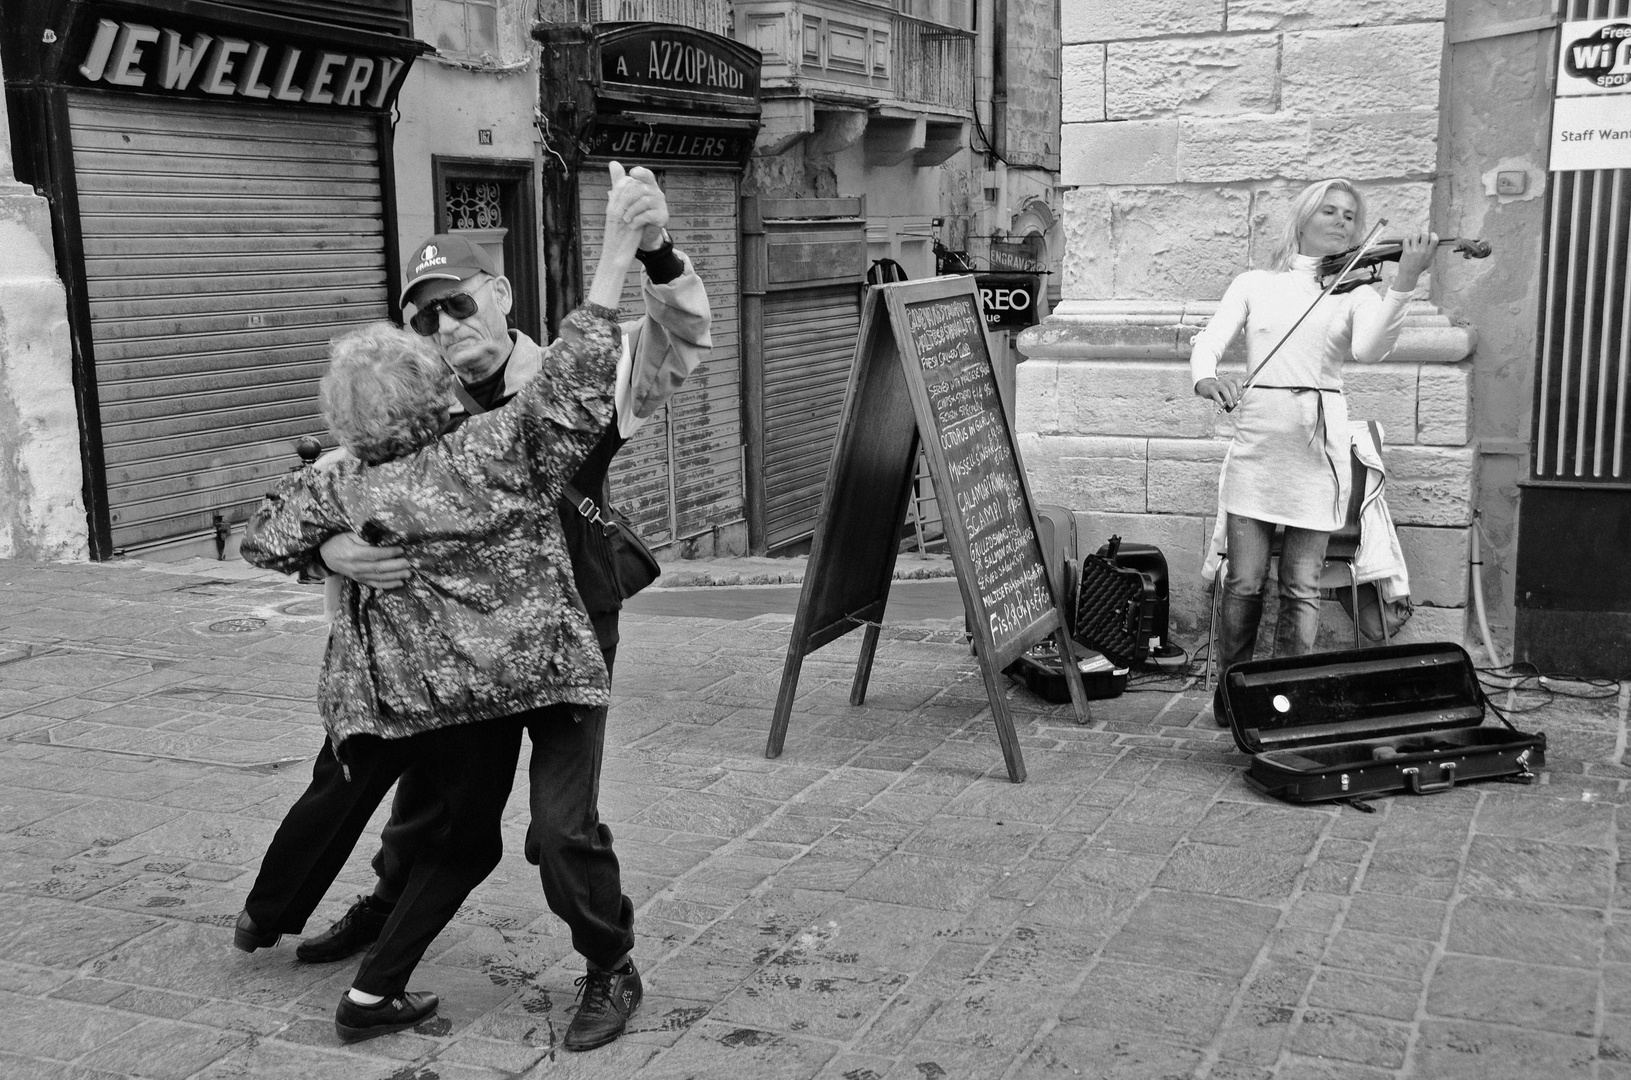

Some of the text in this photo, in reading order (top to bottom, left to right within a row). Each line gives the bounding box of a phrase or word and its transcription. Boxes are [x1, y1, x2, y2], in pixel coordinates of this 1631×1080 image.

[1601, 27, 1631, 39] Free
[79, 18, 405, 108] JEWELLERY
[648, 40, 744, 89] AZZOPARDI
[1597, 74, 1627, 87] spot
[612, 131, 727, 156] JEWELLERS
[1561, 130, 1595, 142] Staff
[415, 256, 447, 274] FRANCE
[941, 427, 969, 450] OCTOPUS
[965, 497, 1003, 537] SCAMPI
